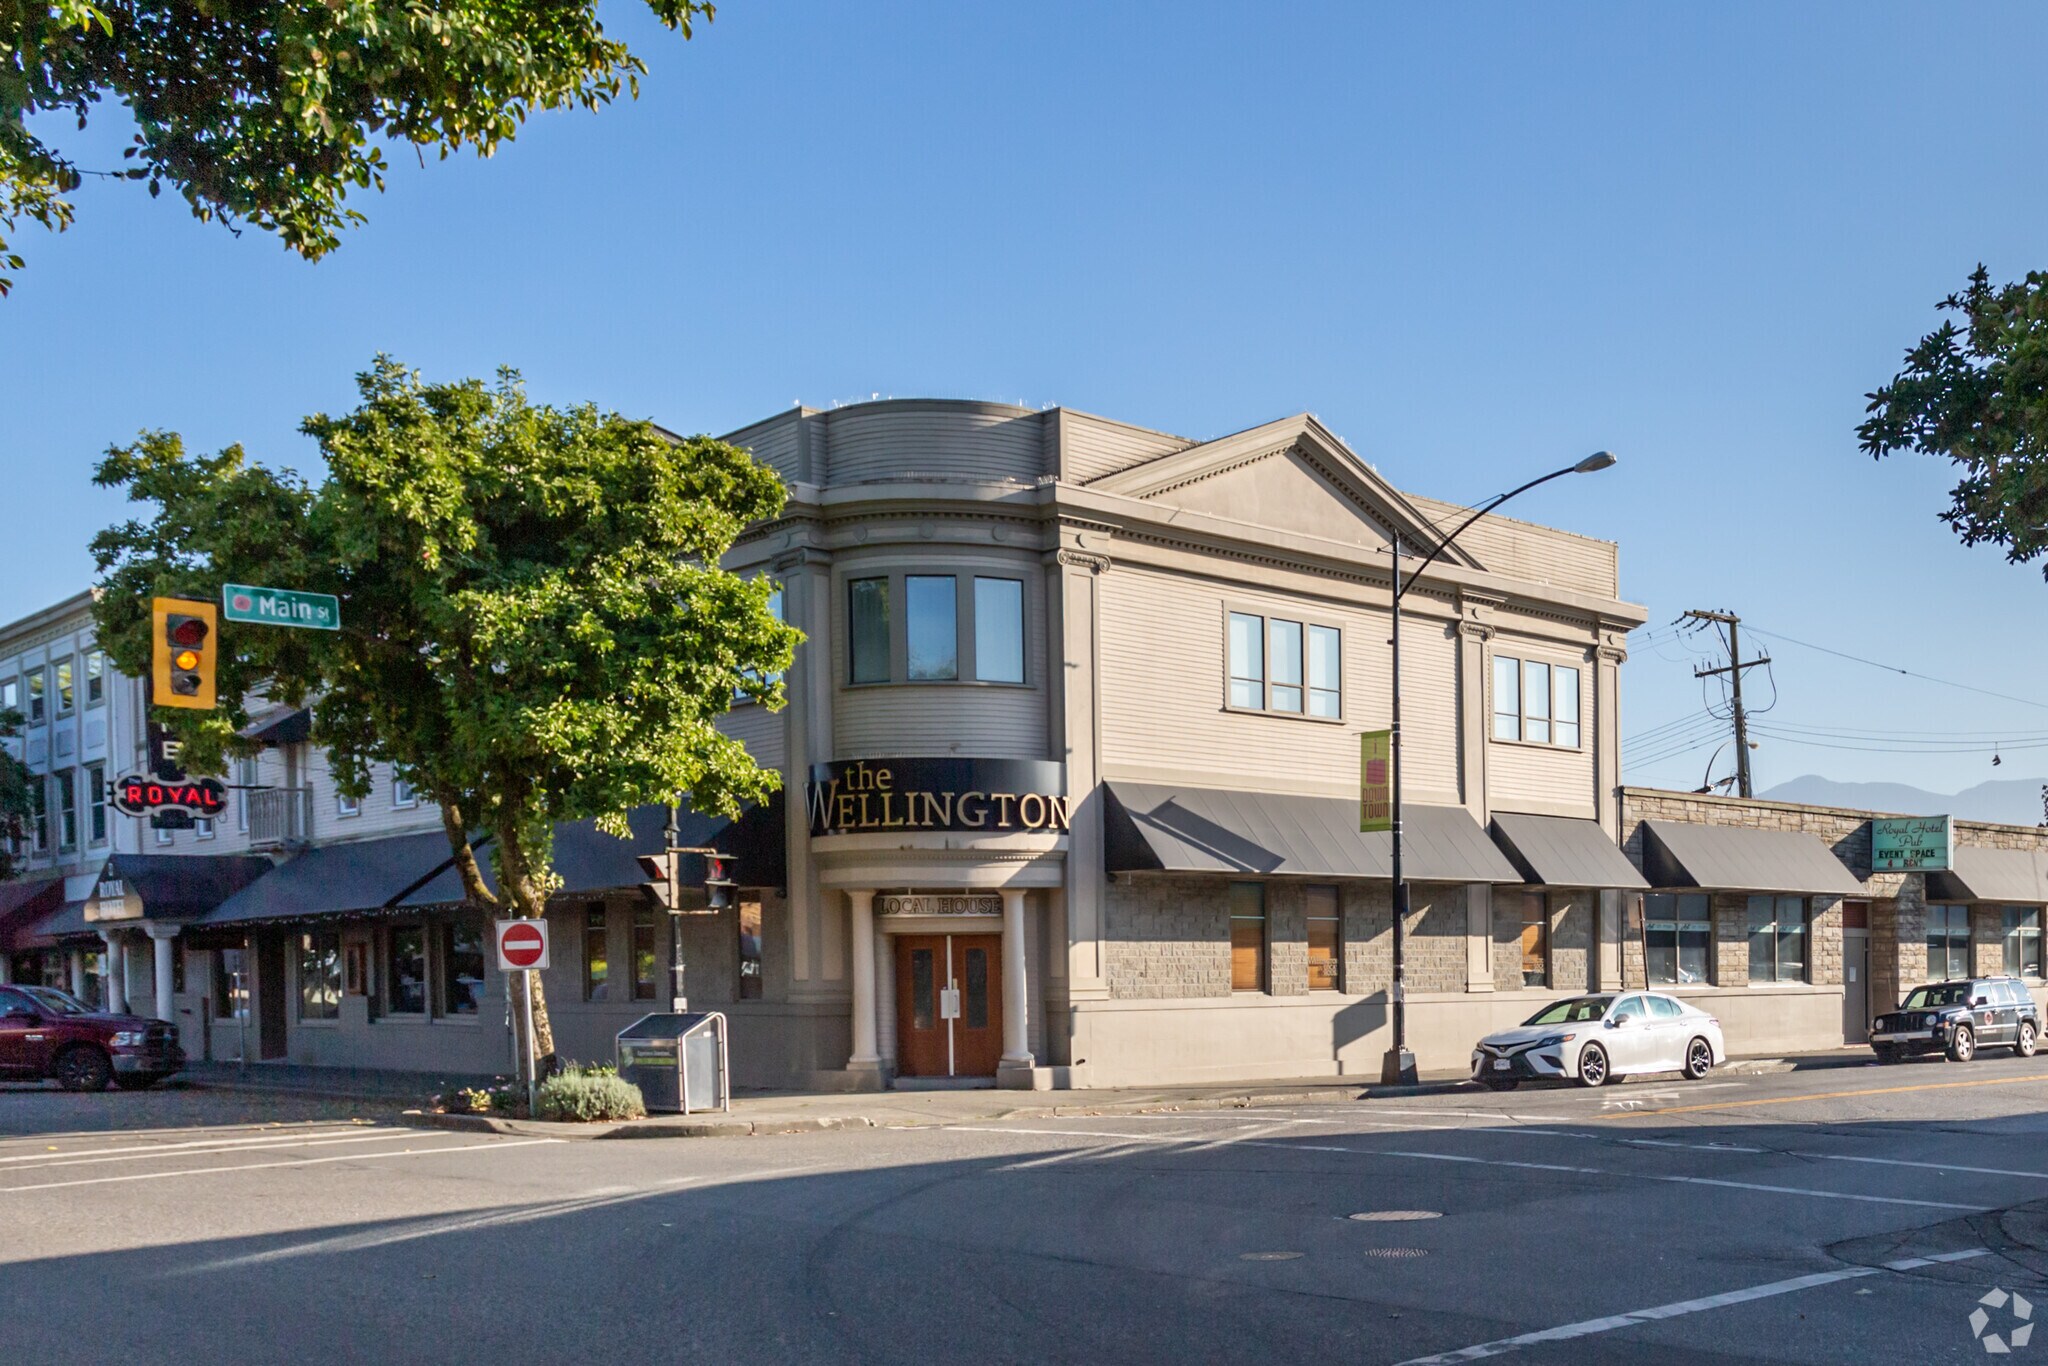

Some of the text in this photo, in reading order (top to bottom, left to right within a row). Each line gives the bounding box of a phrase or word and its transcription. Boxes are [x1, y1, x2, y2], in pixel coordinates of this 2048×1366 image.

[259, 596, 311, 619] Main
[845, 761, 892, 790] the
[126, 785, 217, 805] ROYAL
[802, 778, 1071, 830] WELLINGTON
[1362, 787, 1389, 803] DOWN
[1362, 802, 1389, 819] TOWN
[1876, 820, 1945, 838] Royal Hotel
[1898, 834, 1923, 848] Pub
[1878, 849, 1904, 859] EVENT
[1903, 859, 1925, 868] RENT
[879, 897, 1002, 915] LOCAL HOUSE
